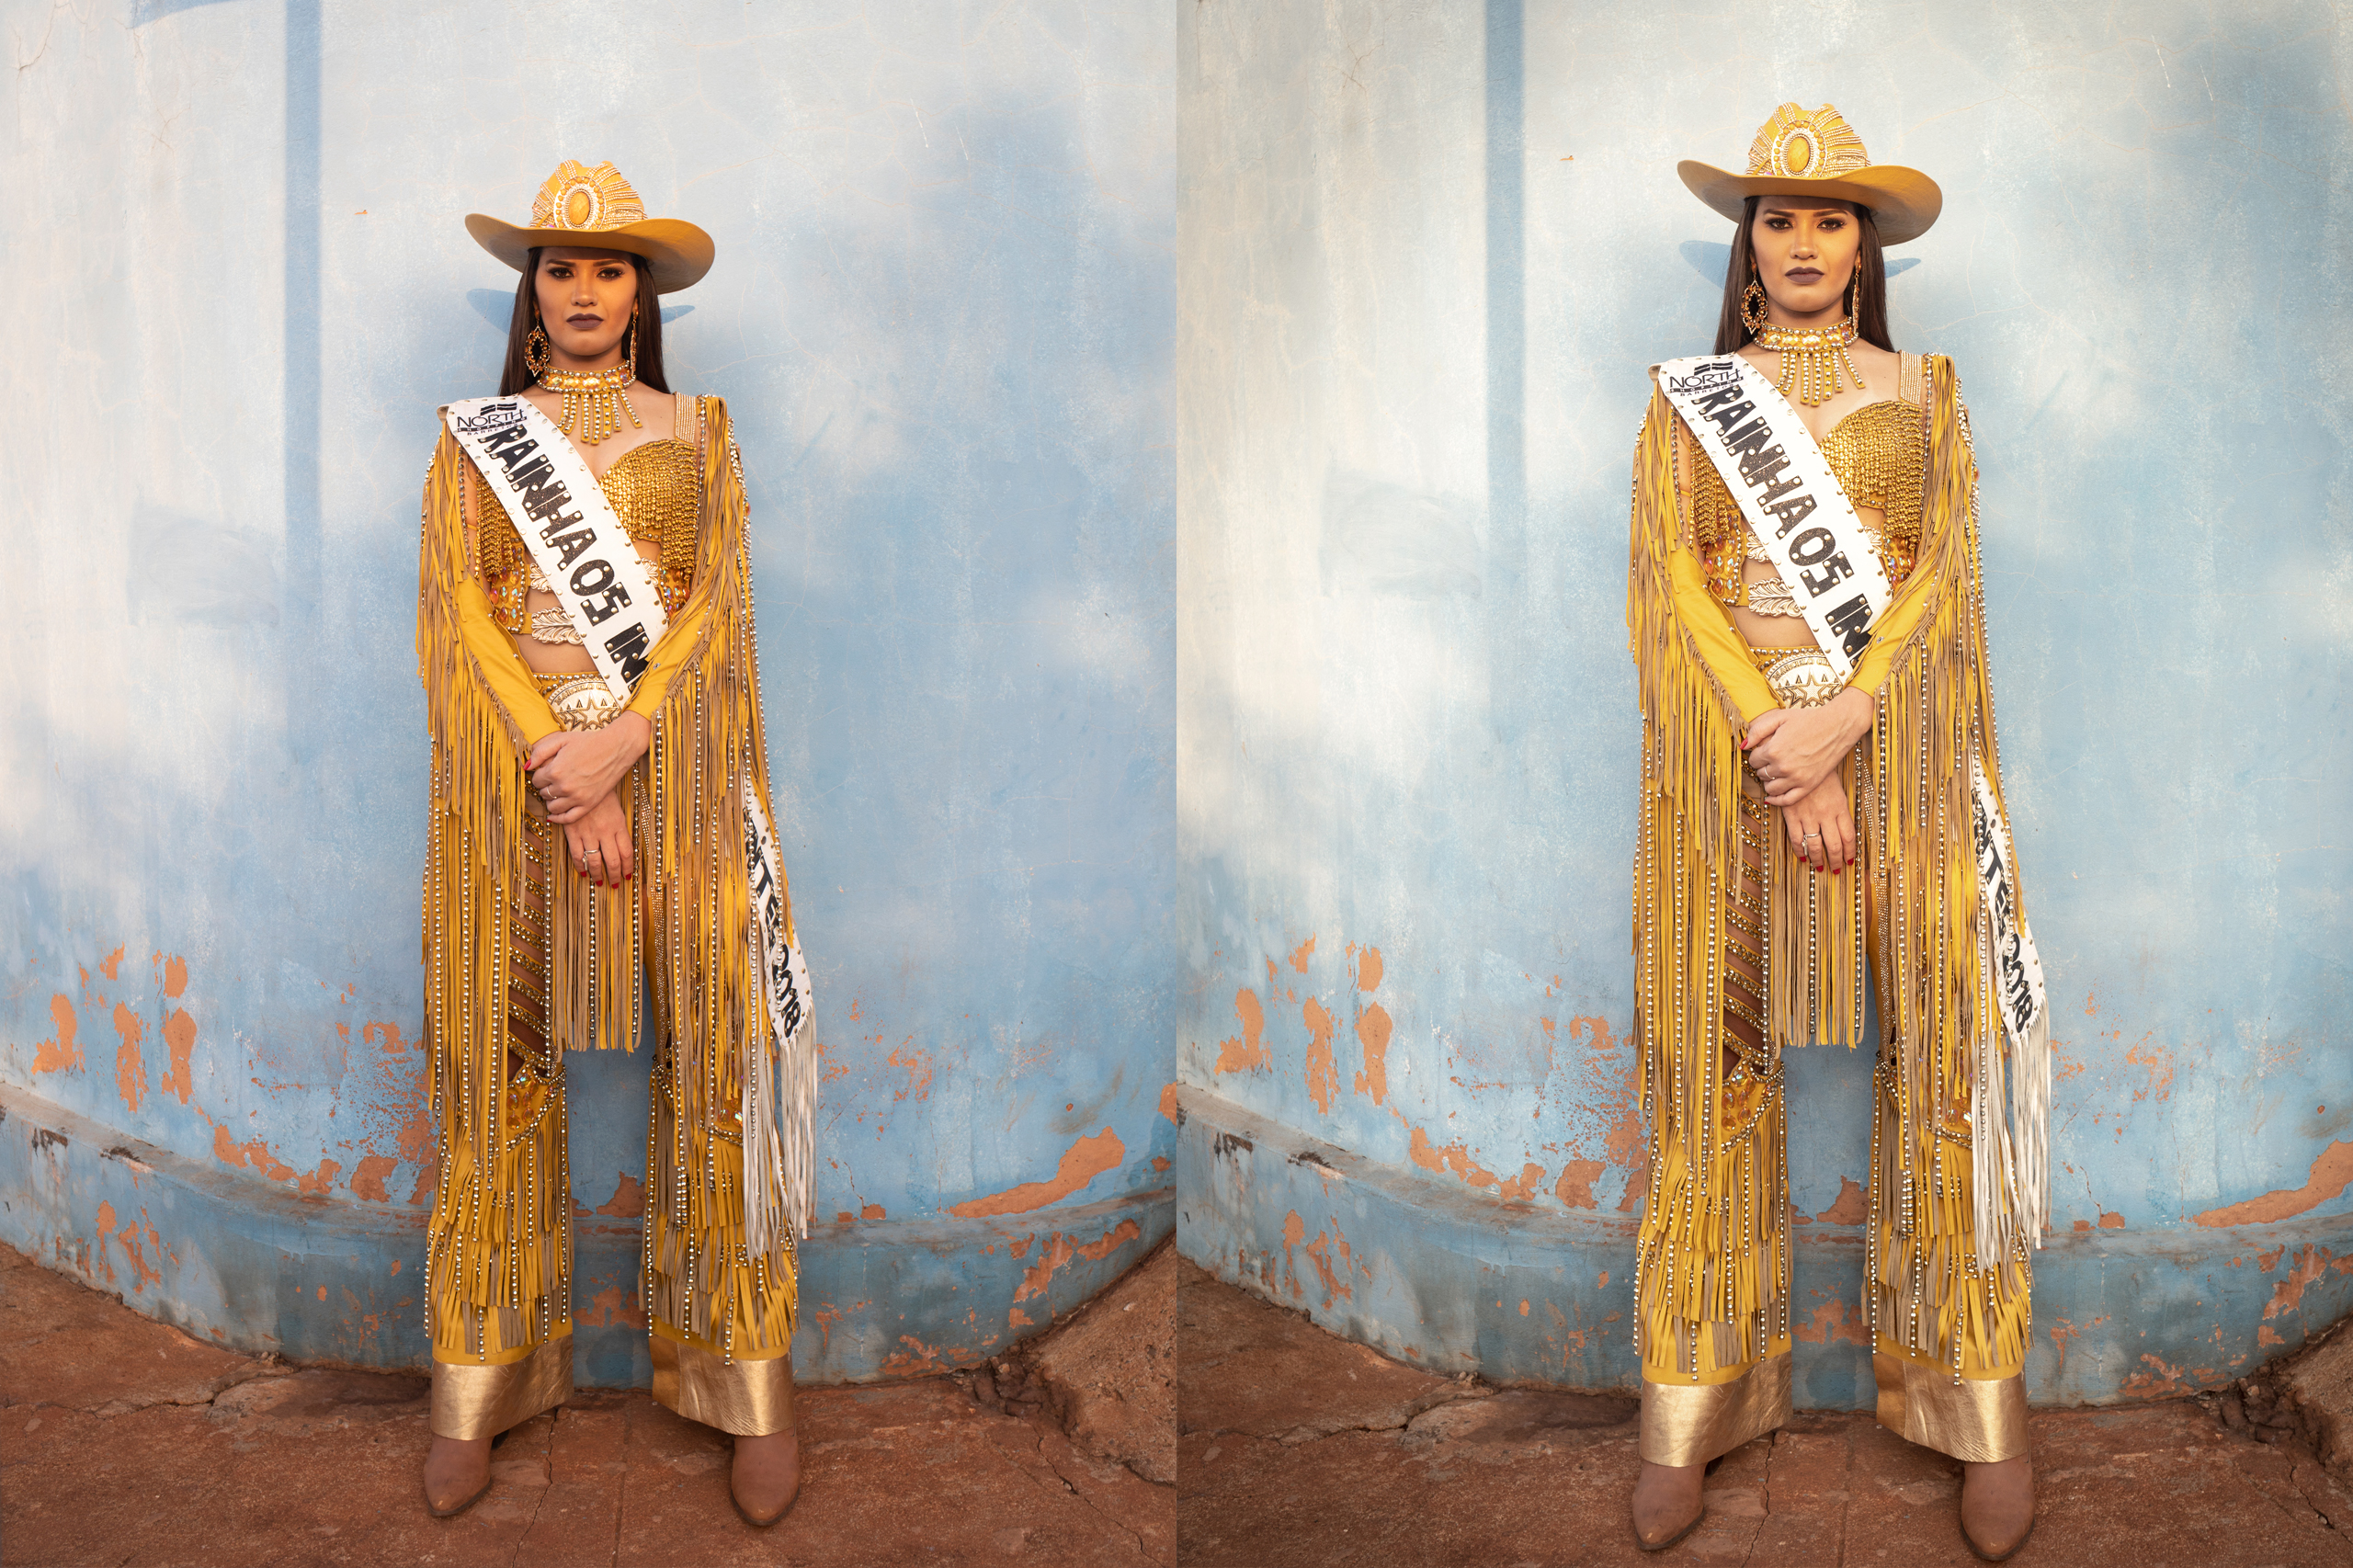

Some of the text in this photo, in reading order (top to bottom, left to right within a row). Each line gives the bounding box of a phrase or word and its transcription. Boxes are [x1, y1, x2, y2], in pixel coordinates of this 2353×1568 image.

[1669, 369, 1741, 388] NORTH
[1670, 376, 1744, 393] SHOPPING
[1680, 384, 1734, 397] BARRETOS
[457, 408, 524, 427] NORTH
[458, 416, 527, 433] SHOPPING
[467, 424, 518, 436] BARRETOS
[1690, 384, 1818, 540] RAINHA
[1824, 593, 1873, 670] IN
[477, 424, 598, 572] RAINHA
[604, 621, 650, 694] IN
[772, 943, 801, 1038] 2018
[2002, 933, 2033, 1033] 2018
